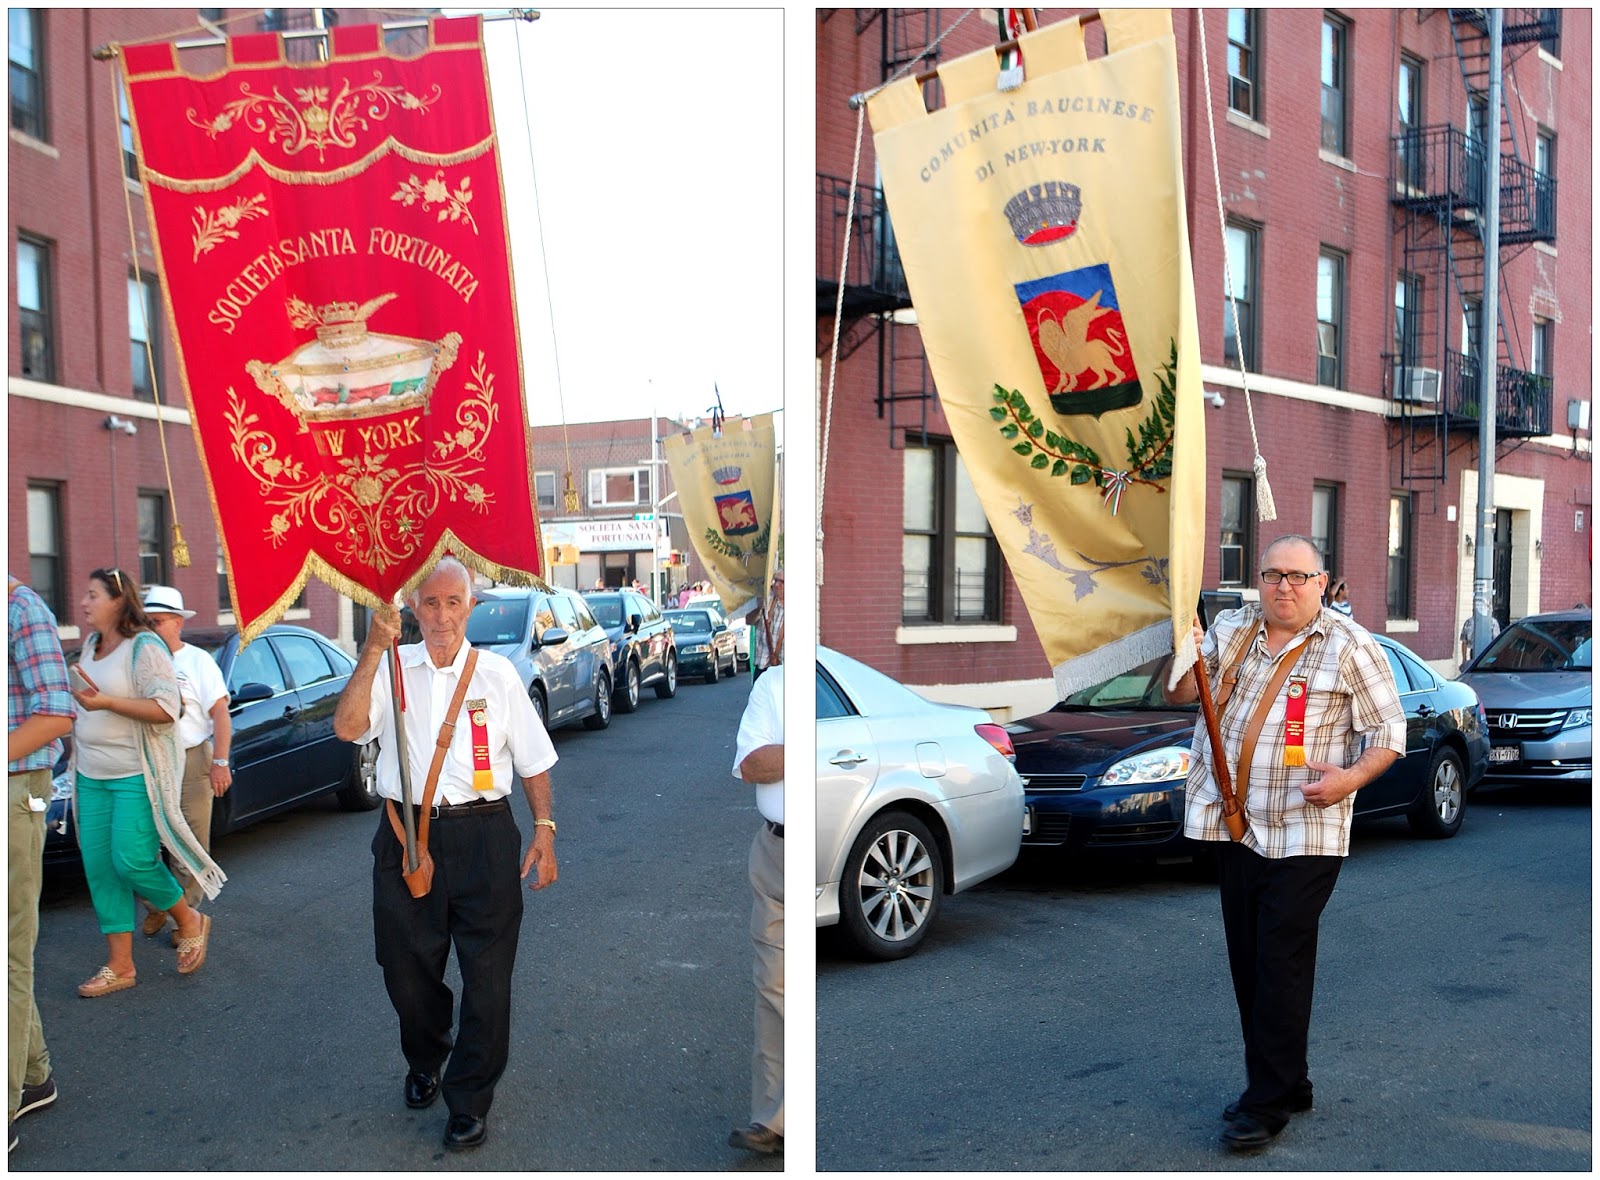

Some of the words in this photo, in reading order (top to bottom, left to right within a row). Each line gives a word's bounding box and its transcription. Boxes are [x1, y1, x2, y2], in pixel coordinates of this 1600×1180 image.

[919, 102, 1016, 183] COMUNITÀ
[1026, 97, 1156, 125] BAUCINESE
[974, 161, 996, 183] DI
[1003, 138, 1107, 167] NEW-YORK
[279, 228, 357, 267] SANTA
[367, 227, 480, 304] FORTUNATA
[357, 415, 423, 453] YORK
[579, 523, 622, 533] SOCIETA
[628, 521, 655, 531] SANT
[591, 533, 652, 543] FORTUNATA
